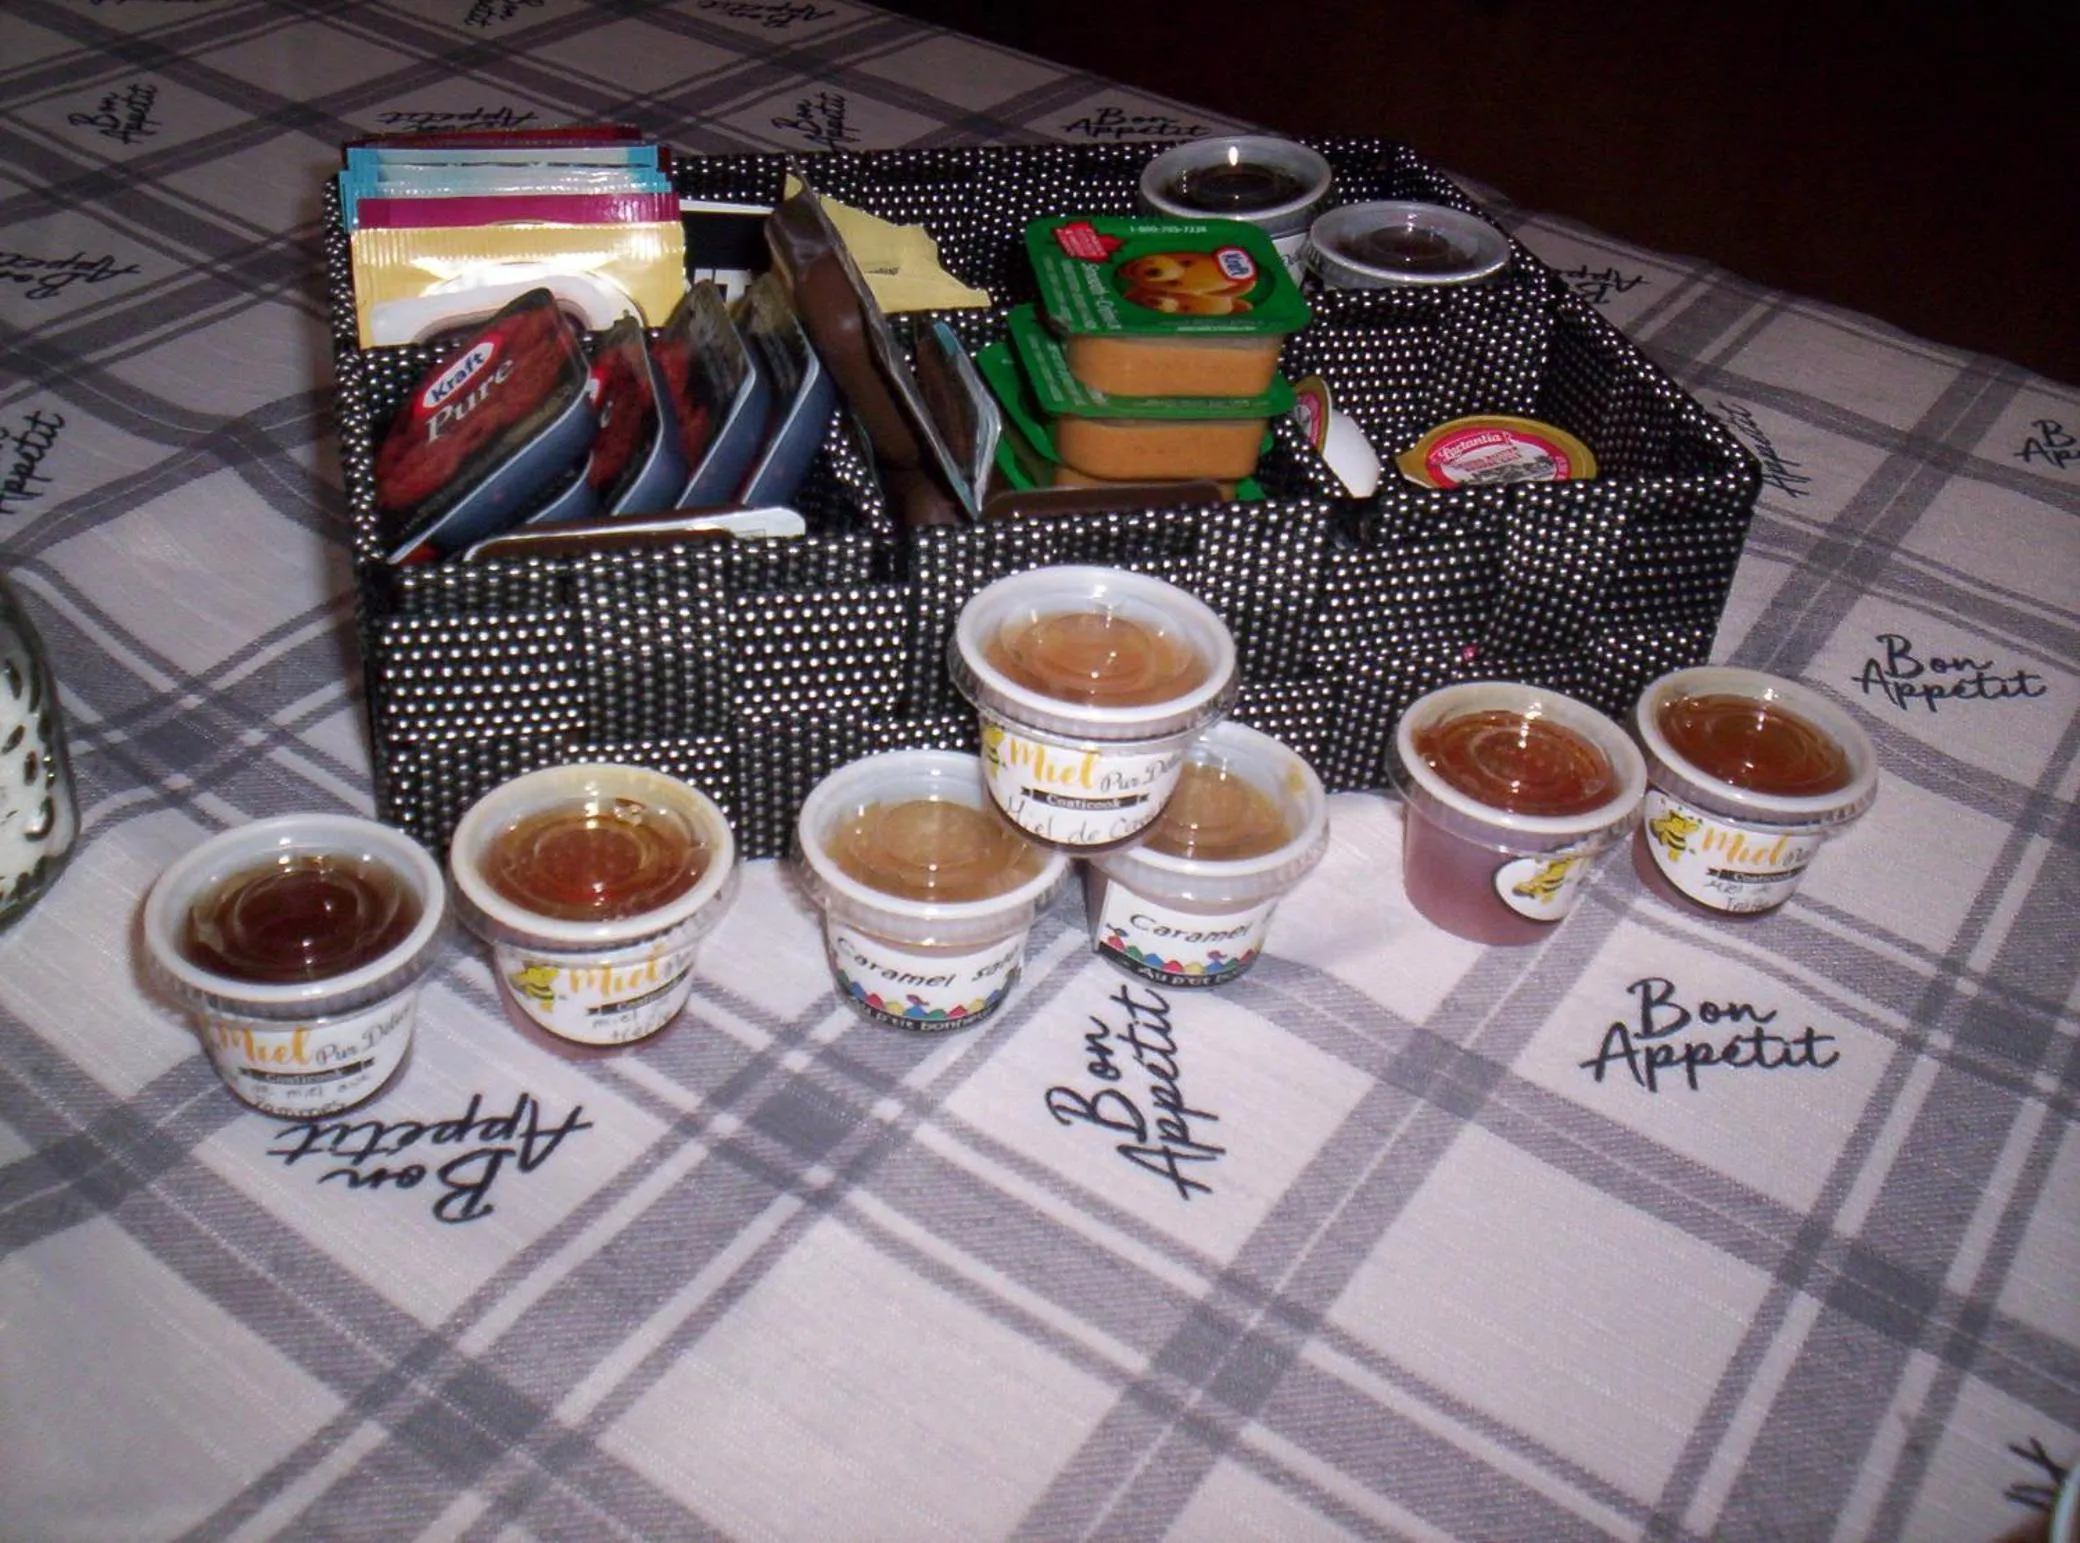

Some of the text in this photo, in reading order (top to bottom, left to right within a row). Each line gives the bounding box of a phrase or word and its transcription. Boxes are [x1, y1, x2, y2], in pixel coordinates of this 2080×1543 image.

[1096, 107, 1180, 125] Bon
[425, 359, 514, 444] Pure
[429, 350, 486, 403] Kraft
[1876, 635, 1994, 680] Bon
[1008, 737, 1099, 790] Miel
[1130, 913, 1254, 944] Caramel
[837, 936, 958, 987] Caramel
[1627, 976, 1778, 1040] Bon
[1045, 1015, 1148, 1144] Bon
[317, 1147, 516, 1224] Bon
